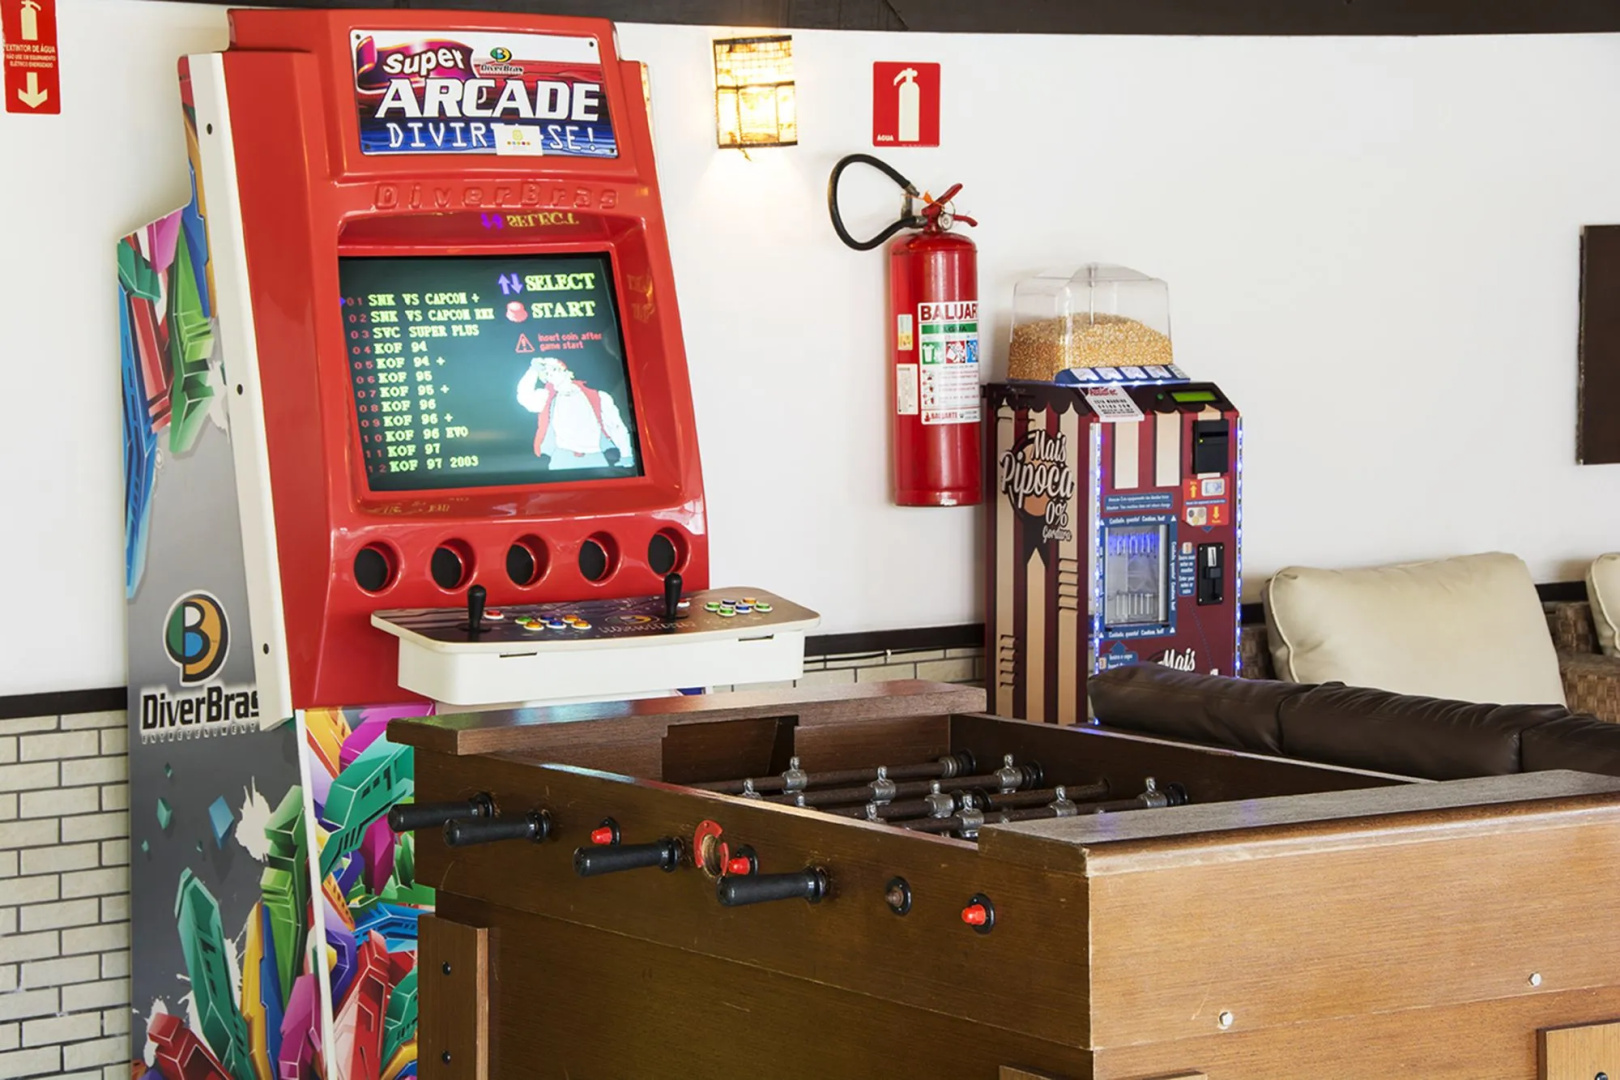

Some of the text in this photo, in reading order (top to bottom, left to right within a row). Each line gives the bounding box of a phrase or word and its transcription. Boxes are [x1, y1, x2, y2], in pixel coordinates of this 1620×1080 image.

[32, 44, 39, 52] DE
[383, 48, 465, 77] Super
[481, 64, 523, 72] DiverBras
[374, 78, 601, 121] ARCADE
[374, 181, 619, 209] DiverBras
[525, 273, 595, 291] SELECT
[368, 294, 396, 306] SNK
[402, 293, 420, 306] VS
[425, 292, 468, 305] CAPCOM
[370, 310, 399, 323] SNK
[405, 310, 423, 322] VS
[428, 308, 471, 321] CAPCOM
[531, 301, 596, 318] START
[373, 326, 401, 339] SVC
[408, 325, 448, 338] SUPER
[451, 324, 480, 337] PLUS
[374, 342, 403, 355] KOF
[411, 340, 428, 353] 94
[376, 357, 405, 370] KOF
[413, 355, 430, 368] 94
[378, 372, 407, 384] KOF
[415, 370, 433, 382] 95
[379, 385, 409, 398] KOF
[417, 384, 435, 396] 95
[381, 400, 411, 412] KOF
[419, 398, 436, 410] 96
[383, 414, 413, 427] KOF
[421, 413, 438, 425] 96
[385, 429, 414, 442] KOF
[423, 428, 440, 440] 96
[445, 426, 469, 438] EVO
[387, 444, 416, 458] KOF
[424, 443, 441, 455] 97
[1028, 430, 1067, 462] Mais
[389, 459, 419, 473] KOF
[426, 458, 443, 470] 97
[450, 455, 479, 468] 2003
[1000, 451, 1074, 509] Pipoca
[1046, 500, 1068, 526] 0%
[1158, 648, 1196, 672] Mais
[143, 686, 259, 729] DiverBras
[142, 723, 256, 745] ENTRETENIMENT
